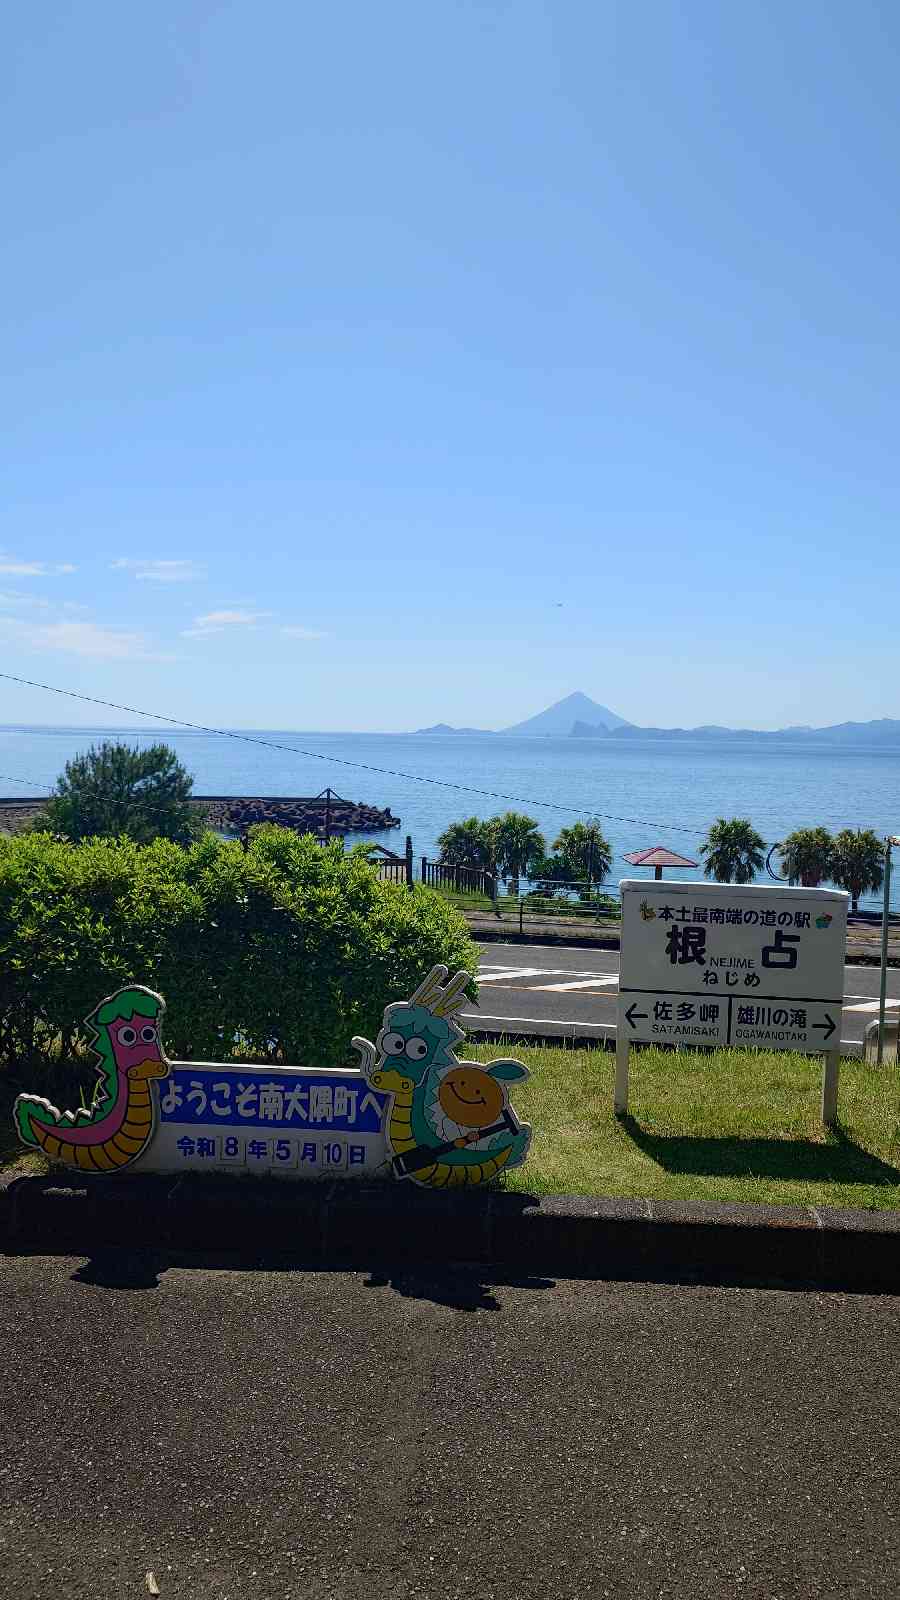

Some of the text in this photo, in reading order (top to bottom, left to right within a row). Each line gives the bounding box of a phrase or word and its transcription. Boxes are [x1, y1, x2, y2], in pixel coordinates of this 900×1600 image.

[658, 905, 811, 929] 本土最南端の道の駅
[709, 957, 755, 969] NEJIME
[702, 970, 761, 988] ねじめ
[653, 1001, 719, 1024] 佐多岬
[736, 1005, 807, 1029] 雄川の滝
[652, 1024, 719, 1037] SATAMISAKI
[735, 1029, 807, 1042] OGAWANOTAKI
[161, 1079, 384, 1124] ようこそ南大隅町へ
